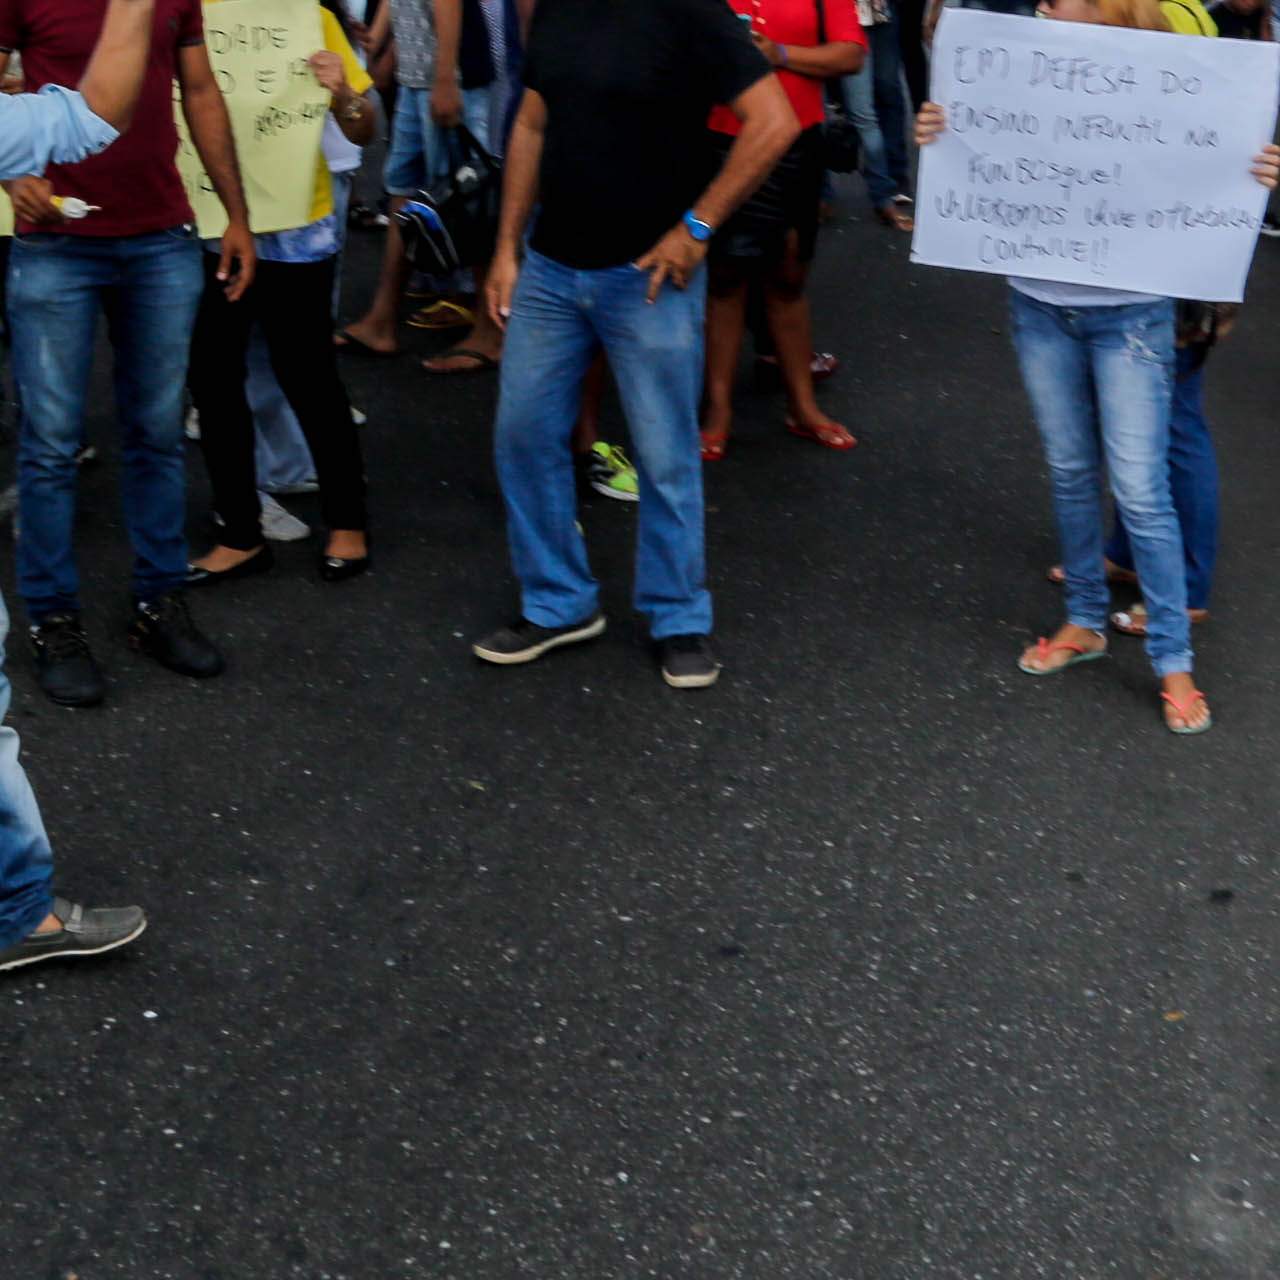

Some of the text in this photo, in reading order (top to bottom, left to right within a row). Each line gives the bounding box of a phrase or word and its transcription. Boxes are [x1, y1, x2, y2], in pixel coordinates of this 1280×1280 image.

[952, 44, 1204, 96] EM DEFESA DO
[949, 100, 1041, 136] ENSINO
